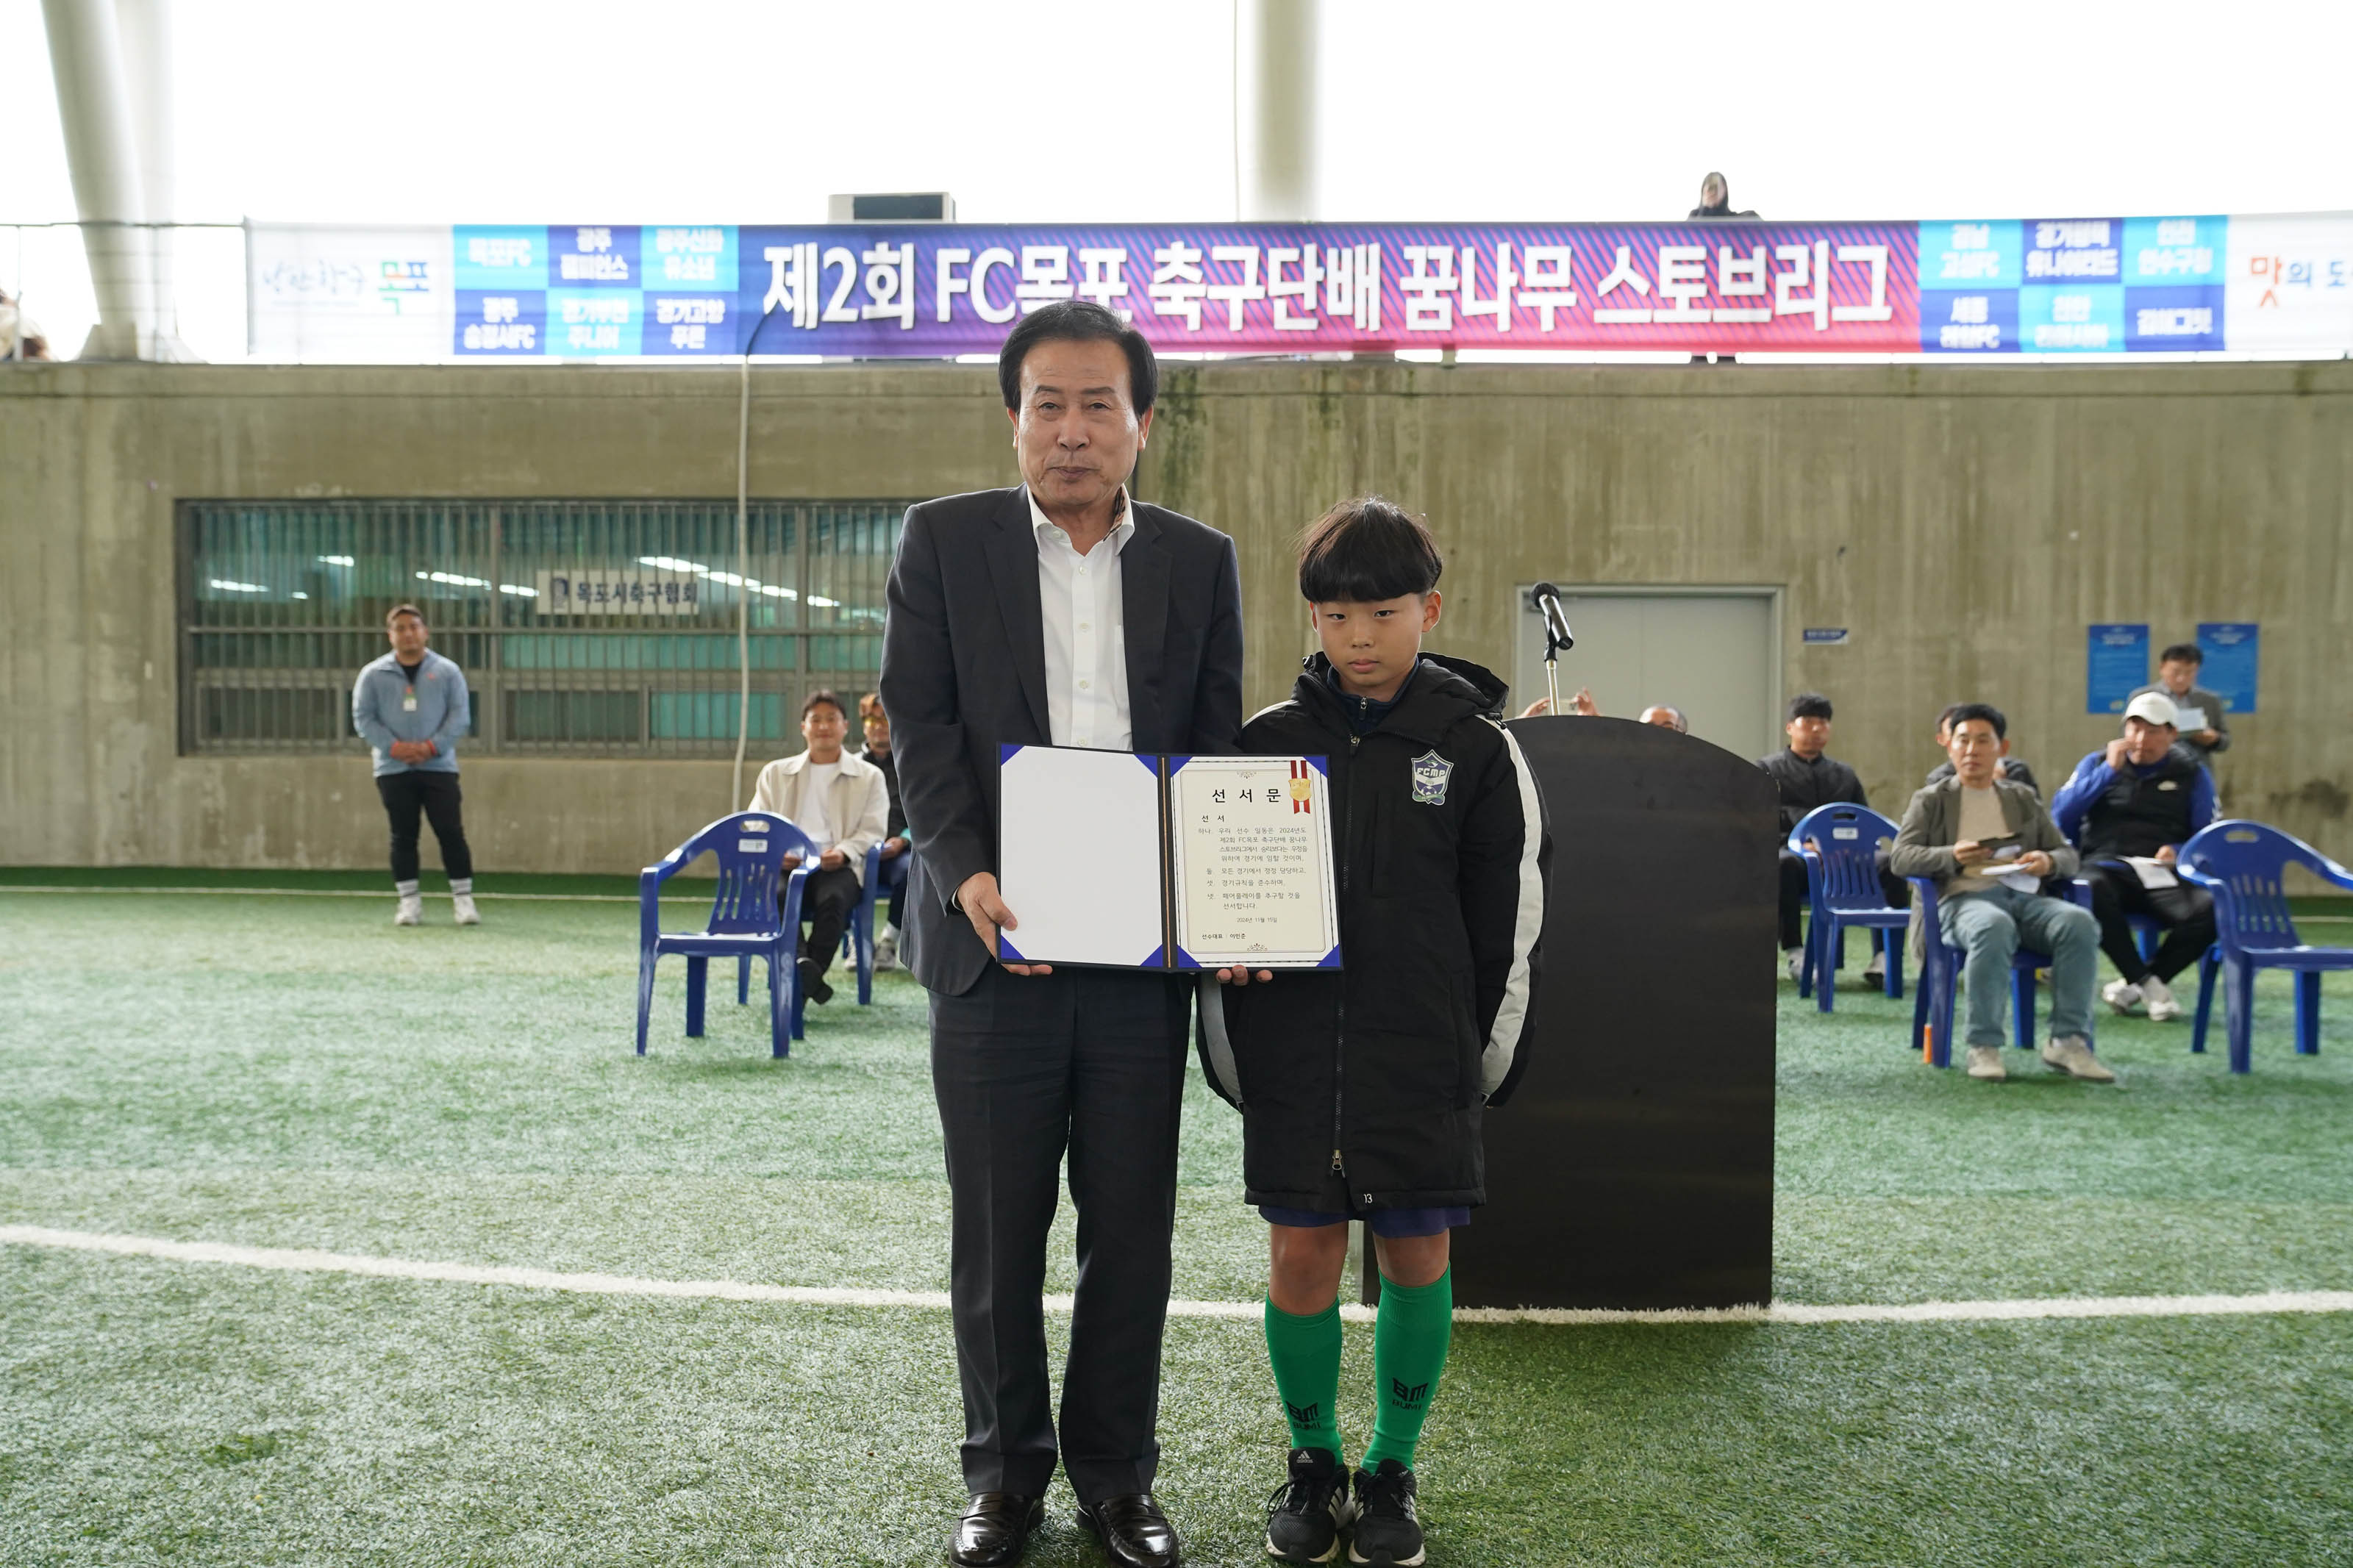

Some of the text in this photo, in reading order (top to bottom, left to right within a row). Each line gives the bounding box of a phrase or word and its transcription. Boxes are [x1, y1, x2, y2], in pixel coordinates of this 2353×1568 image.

[377, 260, 431, 317] 목포
[763, 240, 1894, 332] 제2회 FC목포 축구단배 꿈나무 스토브리그
[2250, 256, 2353, 308] 맛의 도
[1417, 767, 1446, 777] FCMP
[1363, 1193, 1373, 1203] 13
[1392, 1399, 1423, 1411] BUMI
